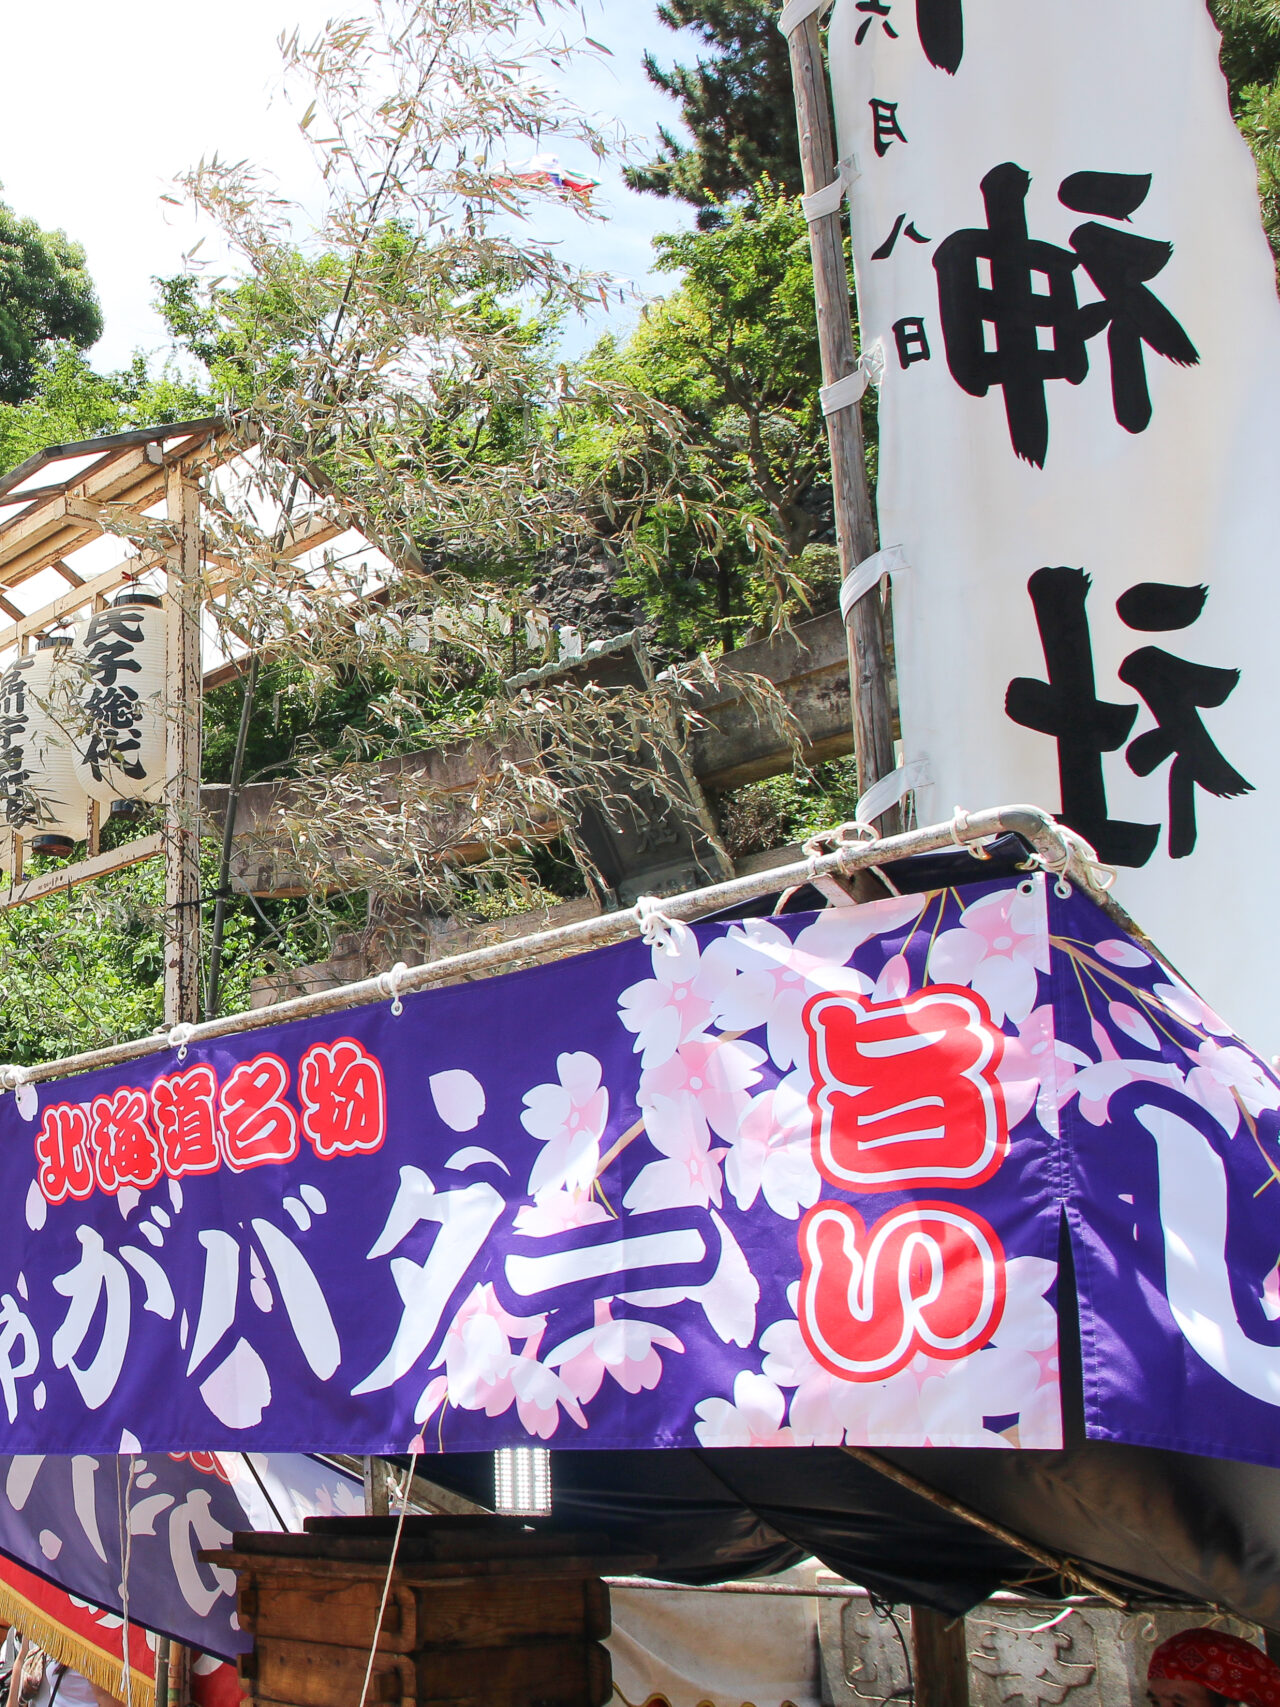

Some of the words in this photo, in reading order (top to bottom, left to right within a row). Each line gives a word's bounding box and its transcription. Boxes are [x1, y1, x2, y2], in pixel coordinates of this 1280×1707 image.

[81, 606, 148, 783] 氏子総代
[36, 1036, 387, 1206] 北海道名物
[797, 983, 1011, 1384] 旨い
